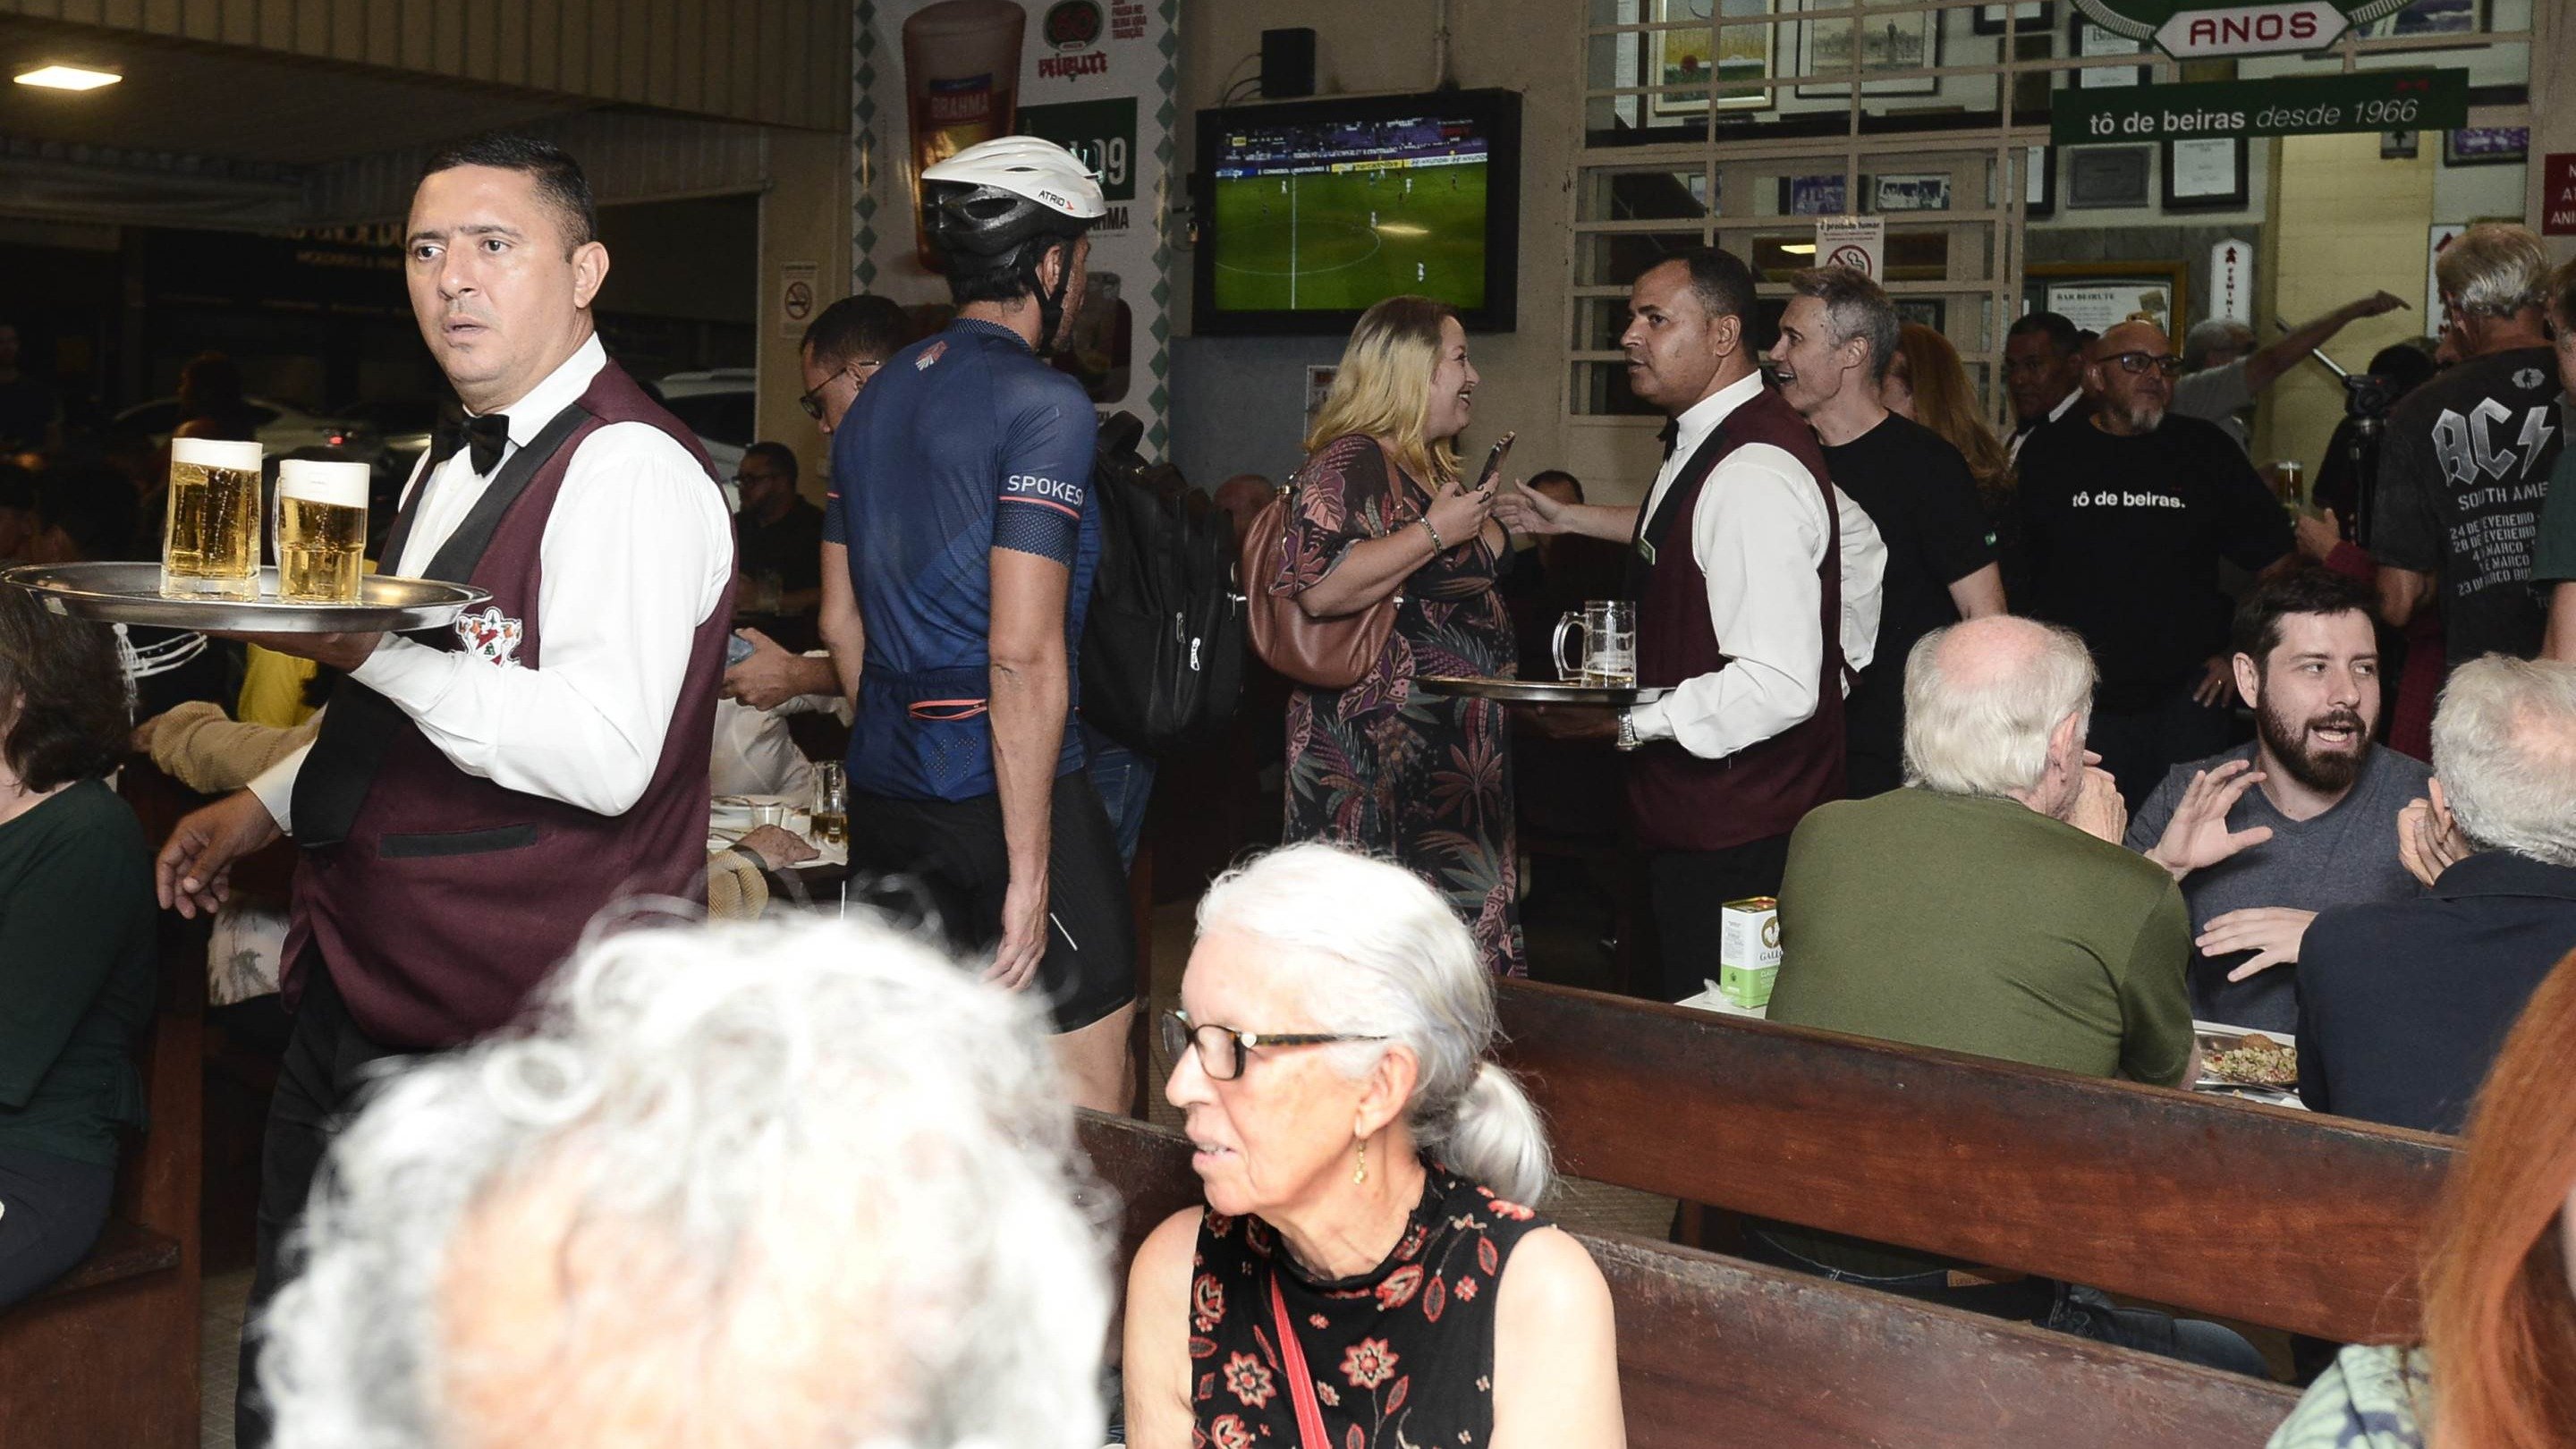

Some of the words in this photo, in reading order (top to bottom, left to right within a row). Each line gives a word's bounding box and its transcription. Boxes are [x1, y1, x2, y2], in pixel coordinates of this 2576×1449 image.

[2190, 12, 2317, 46] ANOS
[2089, 112, 2114, 135] tô
[2123, 112, 2155, 133] de
[2163, 109, 2245, 131] beiras
[2256, 103, 2340, 127] desde
[2353, 98, 2419, 124] 1966
[1038, 190, 1065, 207] ATRIO
[2072, 491, 2089, 507] tô
[2094, 491, 2118, 506] de
[2123, 491, 2186, 508] beiras.
[2458, 487, 2506, 511] SOUTH
[2450, 525, 2466, 539] 24
